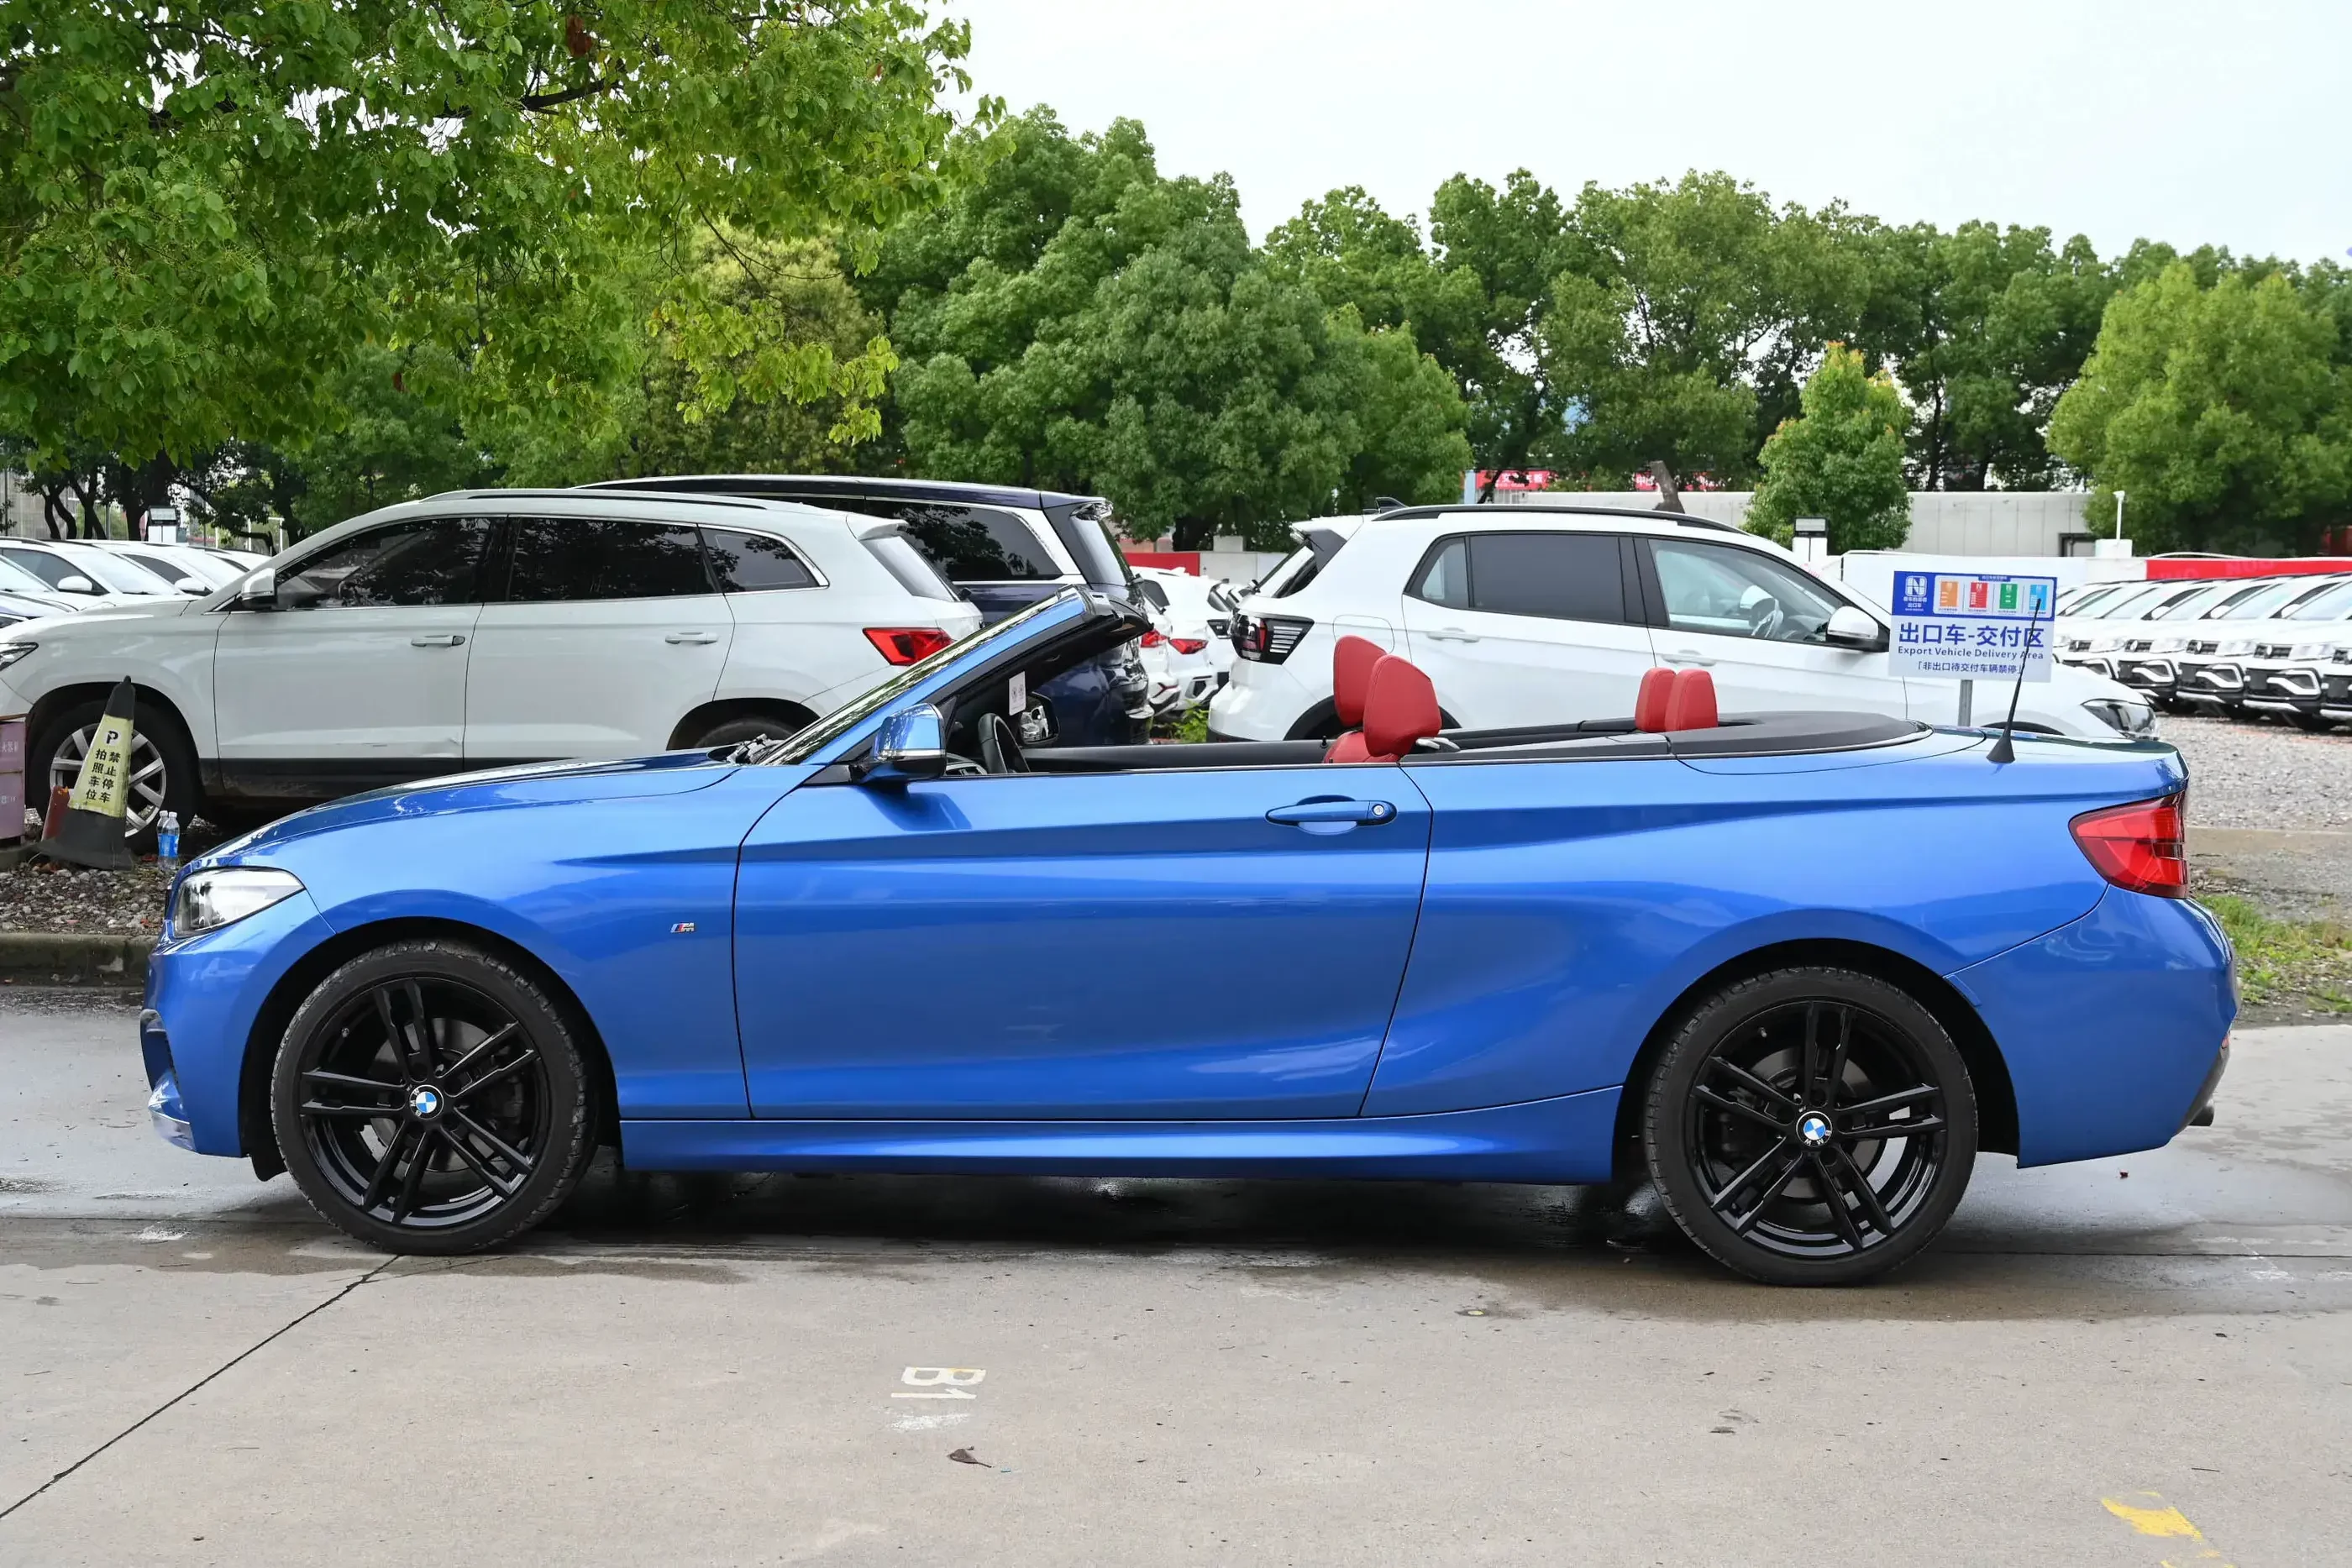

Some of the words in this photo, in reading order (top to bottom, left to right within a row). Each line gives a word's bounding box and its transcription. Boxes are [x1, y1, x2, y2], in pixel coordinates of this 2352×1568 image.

[1898, 622, 2045, 648] 出口车-交付区
[1898, 646, 1932, 657] Export
[1935, 647, 1972, 657] Vehicle
[1974, 648, 2018, 661] Delivery
[2019, 650, 2044, 659] Area
[106, 730, 119, 744] P
[86, 748, 108, 801] 拍照车位
[98, 751, 121, 804] 禁止停车
